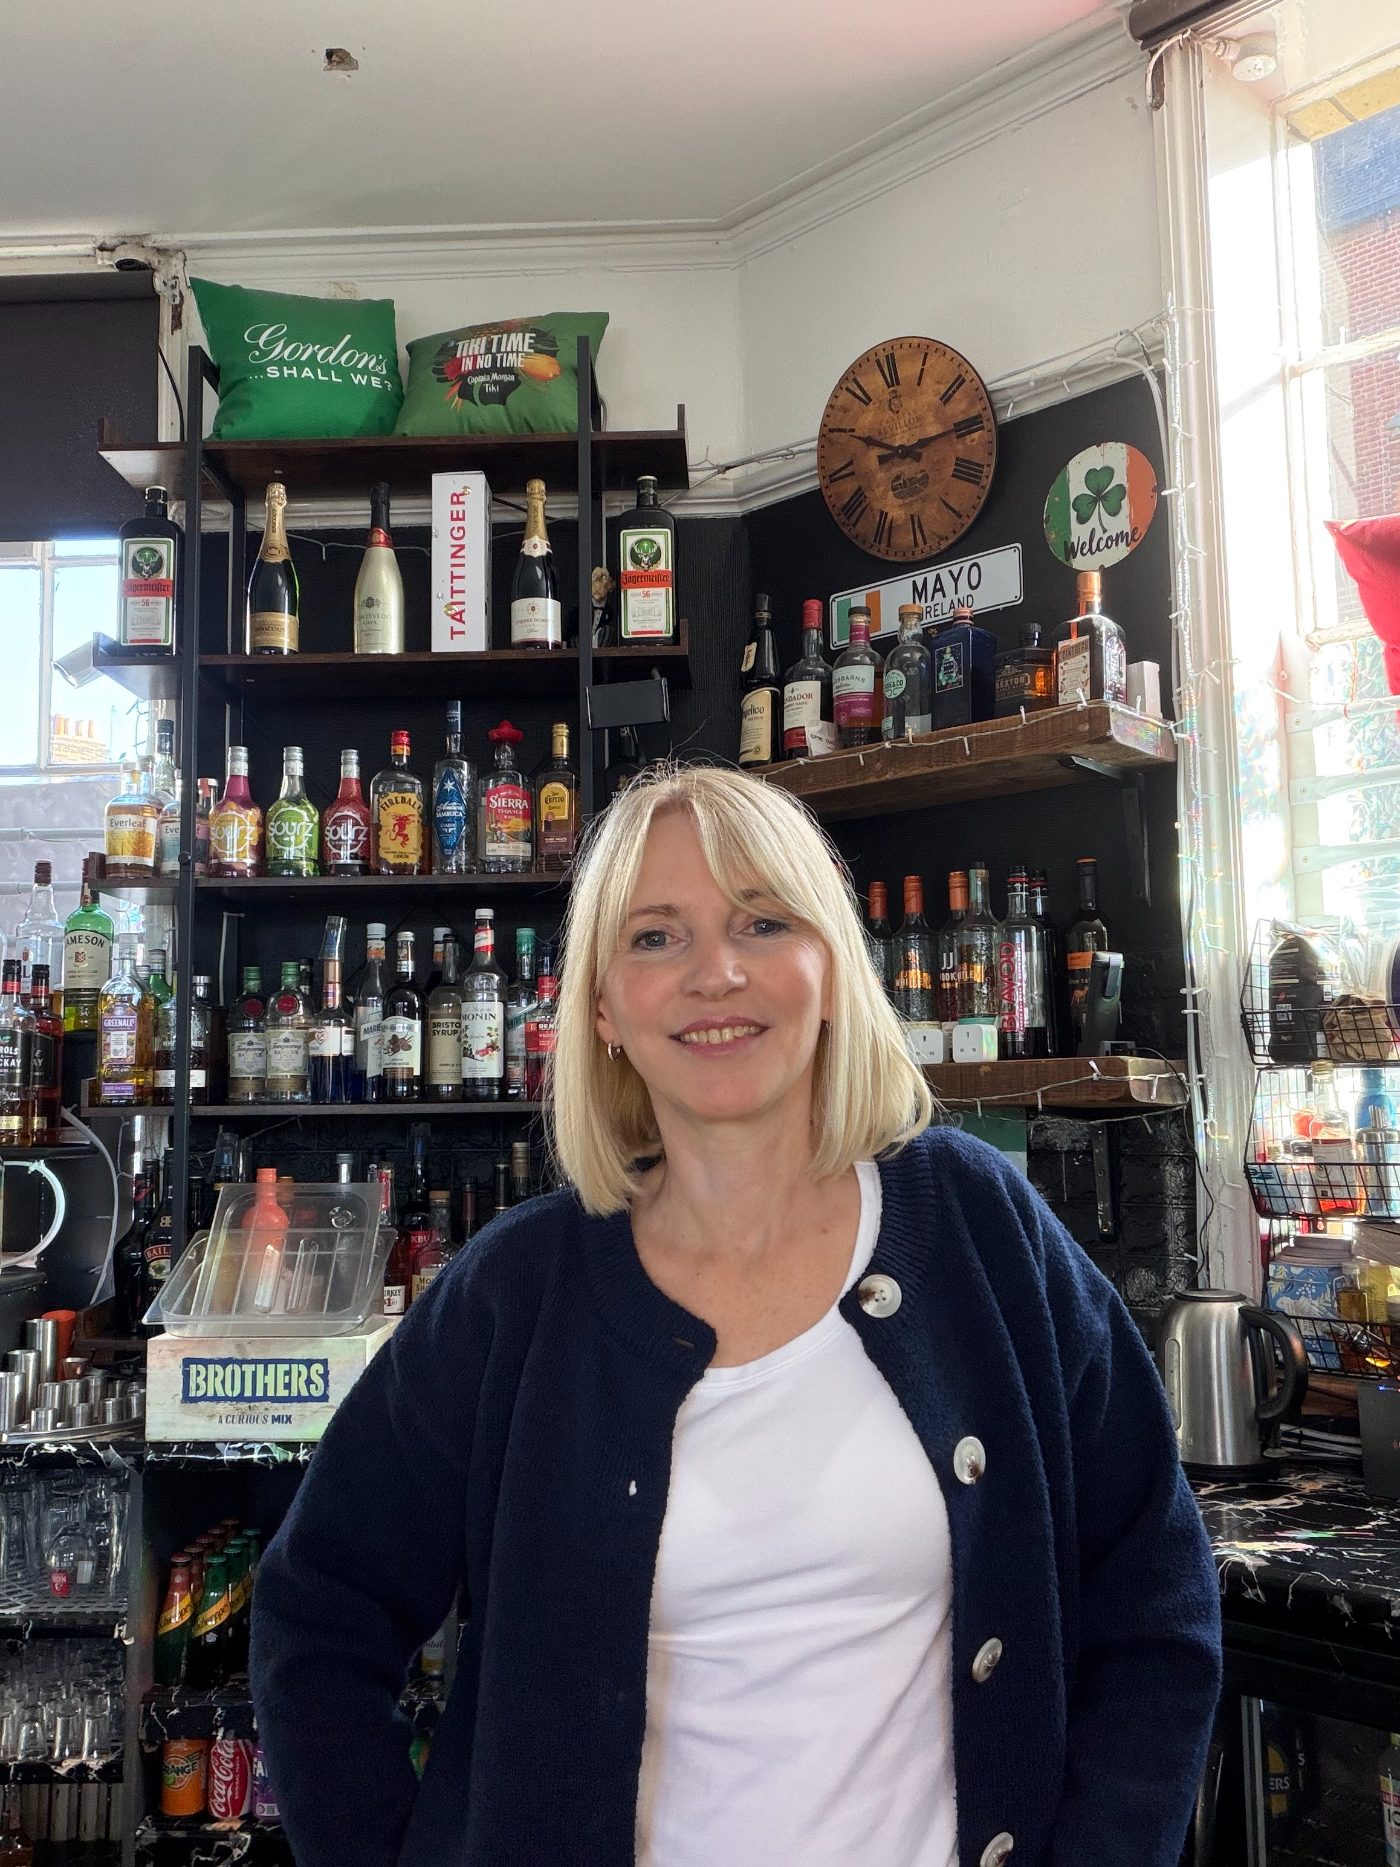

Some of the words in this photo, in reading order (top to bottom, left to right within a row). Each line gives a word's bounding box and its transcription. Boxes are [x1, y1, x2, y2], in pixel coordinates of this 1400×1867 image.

[244, 323, 387, 374] Gordon's
[491, 332, 538, 353] TIME
[460, 357, 473, 372] IN
[476, 353, 493, 370] NO
[496, 352, 526, 368] TIME
[350, 372, 393, 391] WE?
[1063, 525, 1143, 562] Welcome
[449, 492, 466, 640] TAITTINGER
[912, 562, 982, 605] MAYO
[641, 590, 651, 598] 56
[489, 794, 529, 809] SIERRA
[165, 825, 181, 834] Eve
[66, 934, 105, 949] AMESON
[1000, 941, 1016, 1032] BLAVOD
[432, 1021, 461, 1029] BRISTO
[146, 1246, 171, 1258] BAIL
[188, 1363, 325, 1397] BROTHERS
[218, 1415, 223, 1424] A
[225, 1414, 268, 1424] CURIOUS
[271, 1414, 292, 1425] MIX
